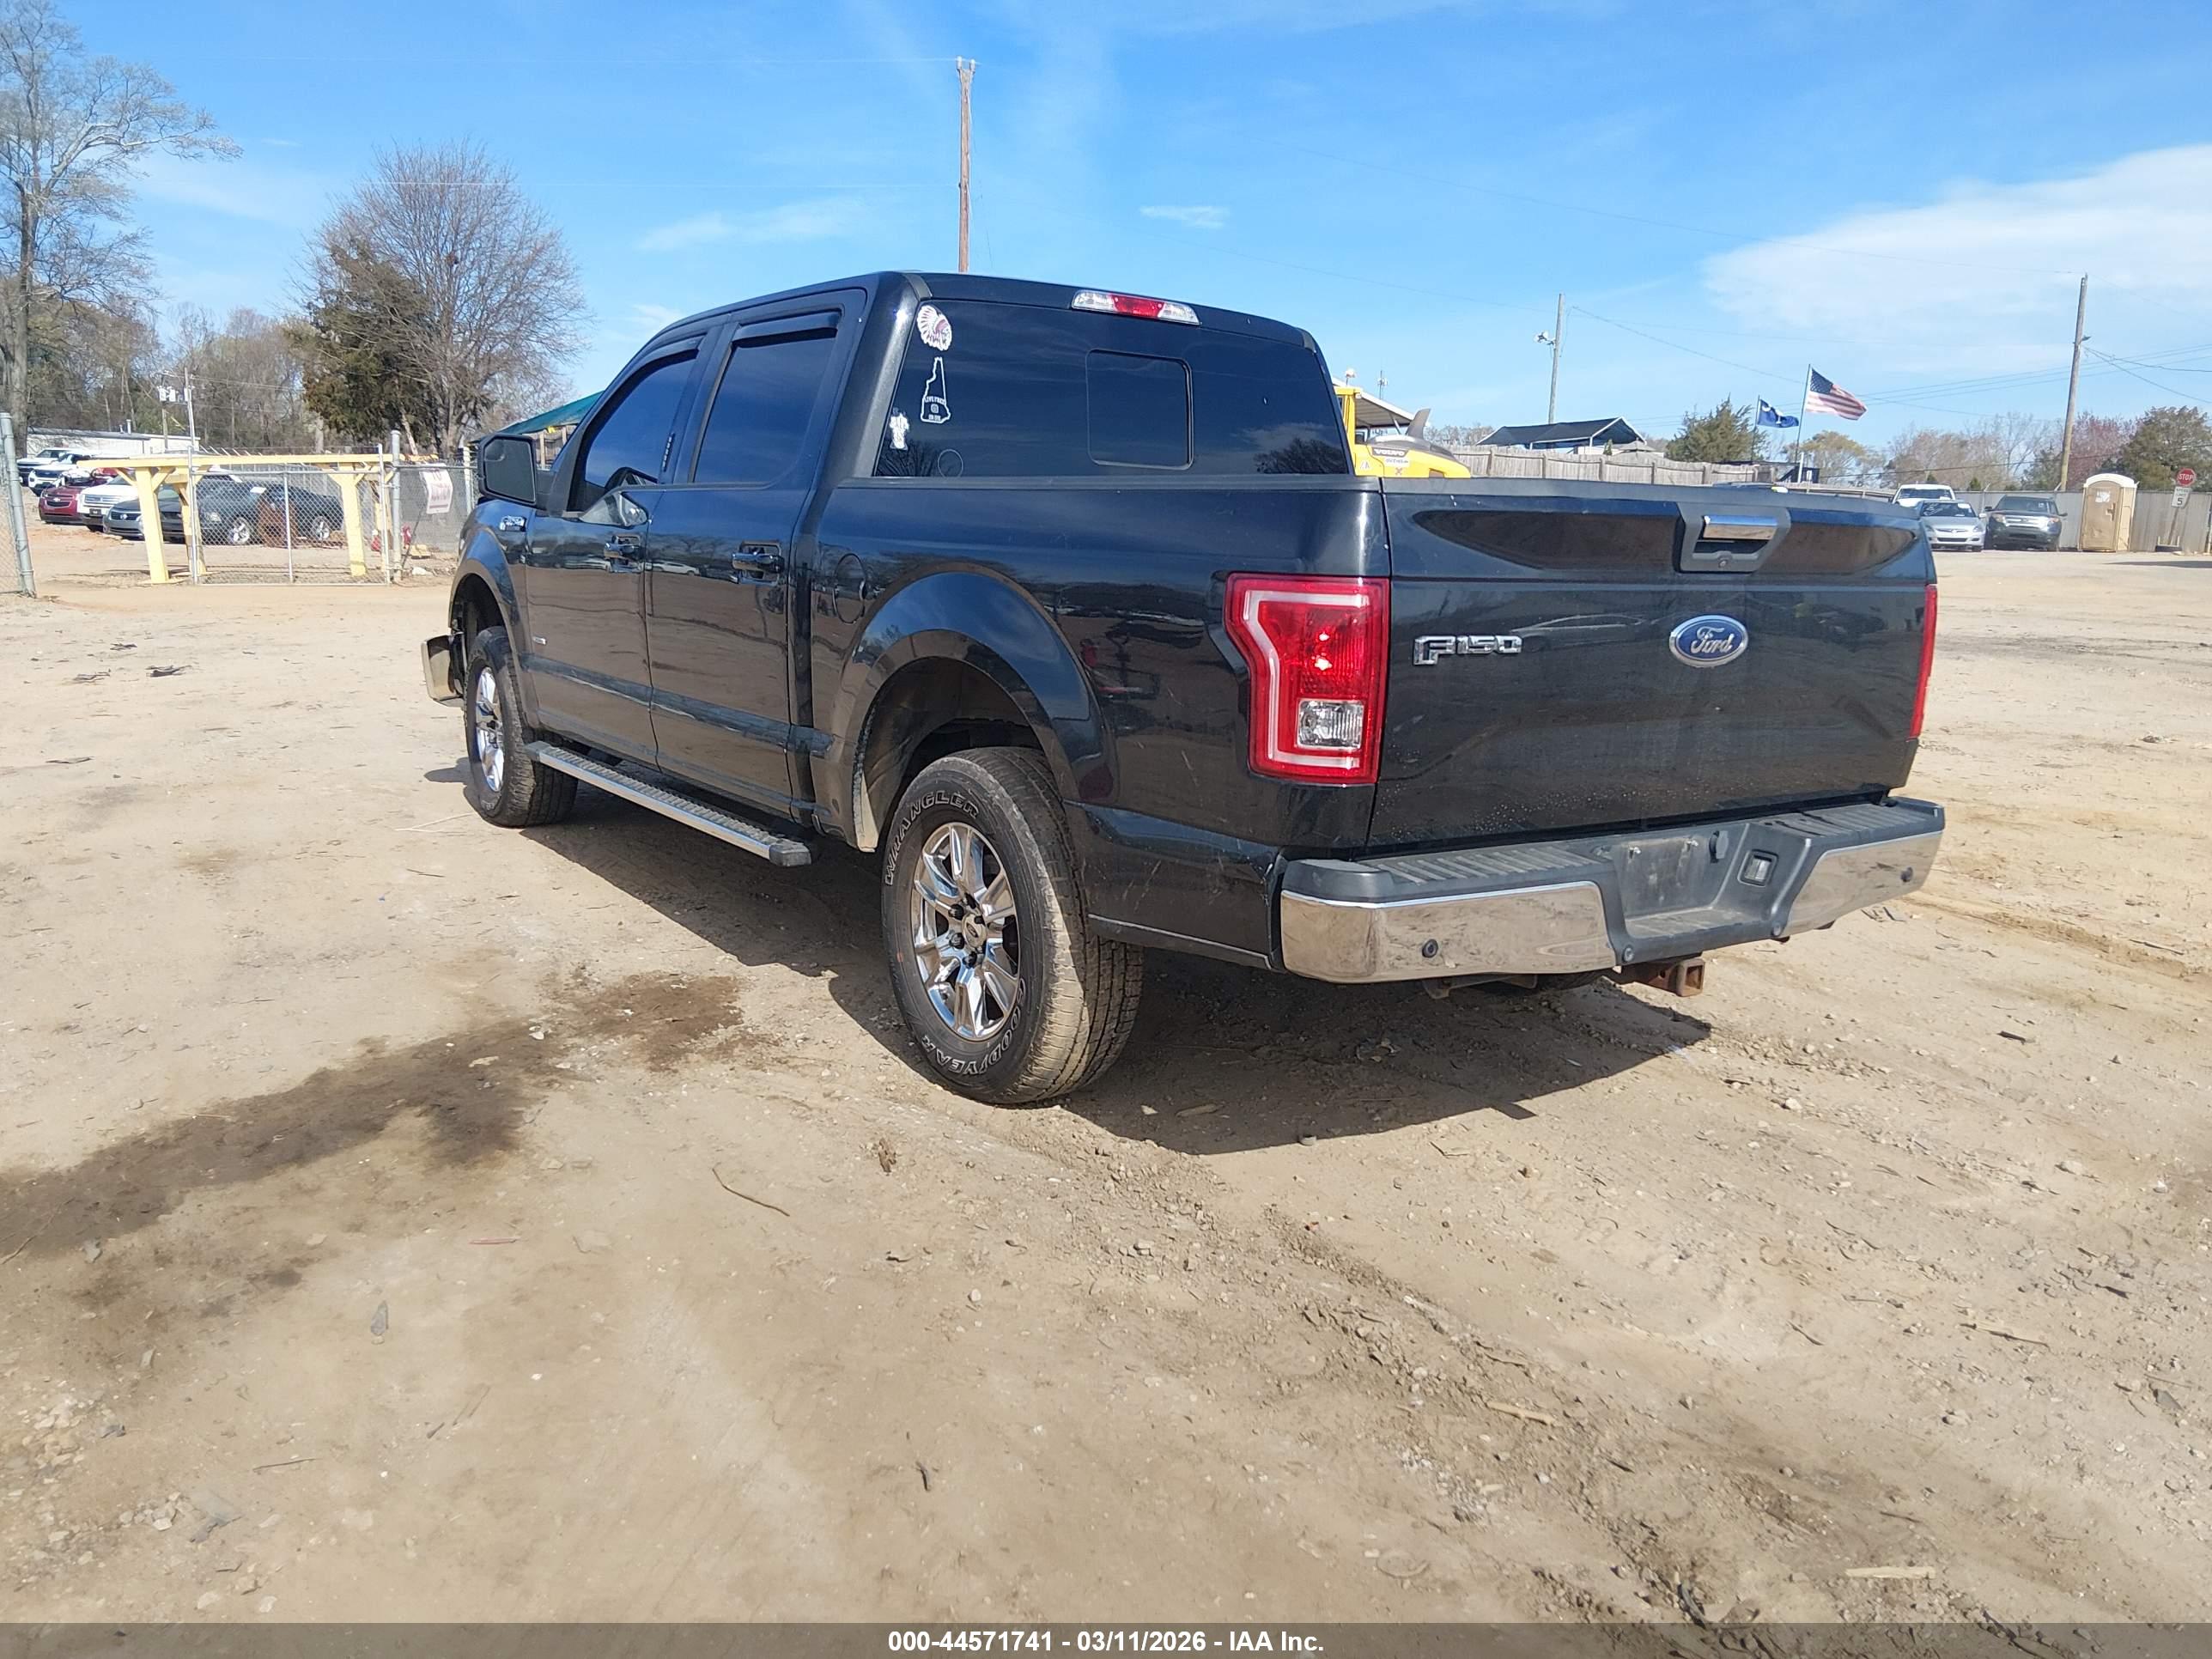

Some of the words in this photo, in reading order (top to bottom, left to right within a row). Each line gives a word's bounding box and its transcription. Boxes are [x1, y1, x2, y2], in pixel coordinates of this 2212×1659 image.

[1690, 626, 1735, 653] Ford
[884, 790, 979, 885] WRANGLER
[921, 978, 1026, 1075] GOODYEAR
